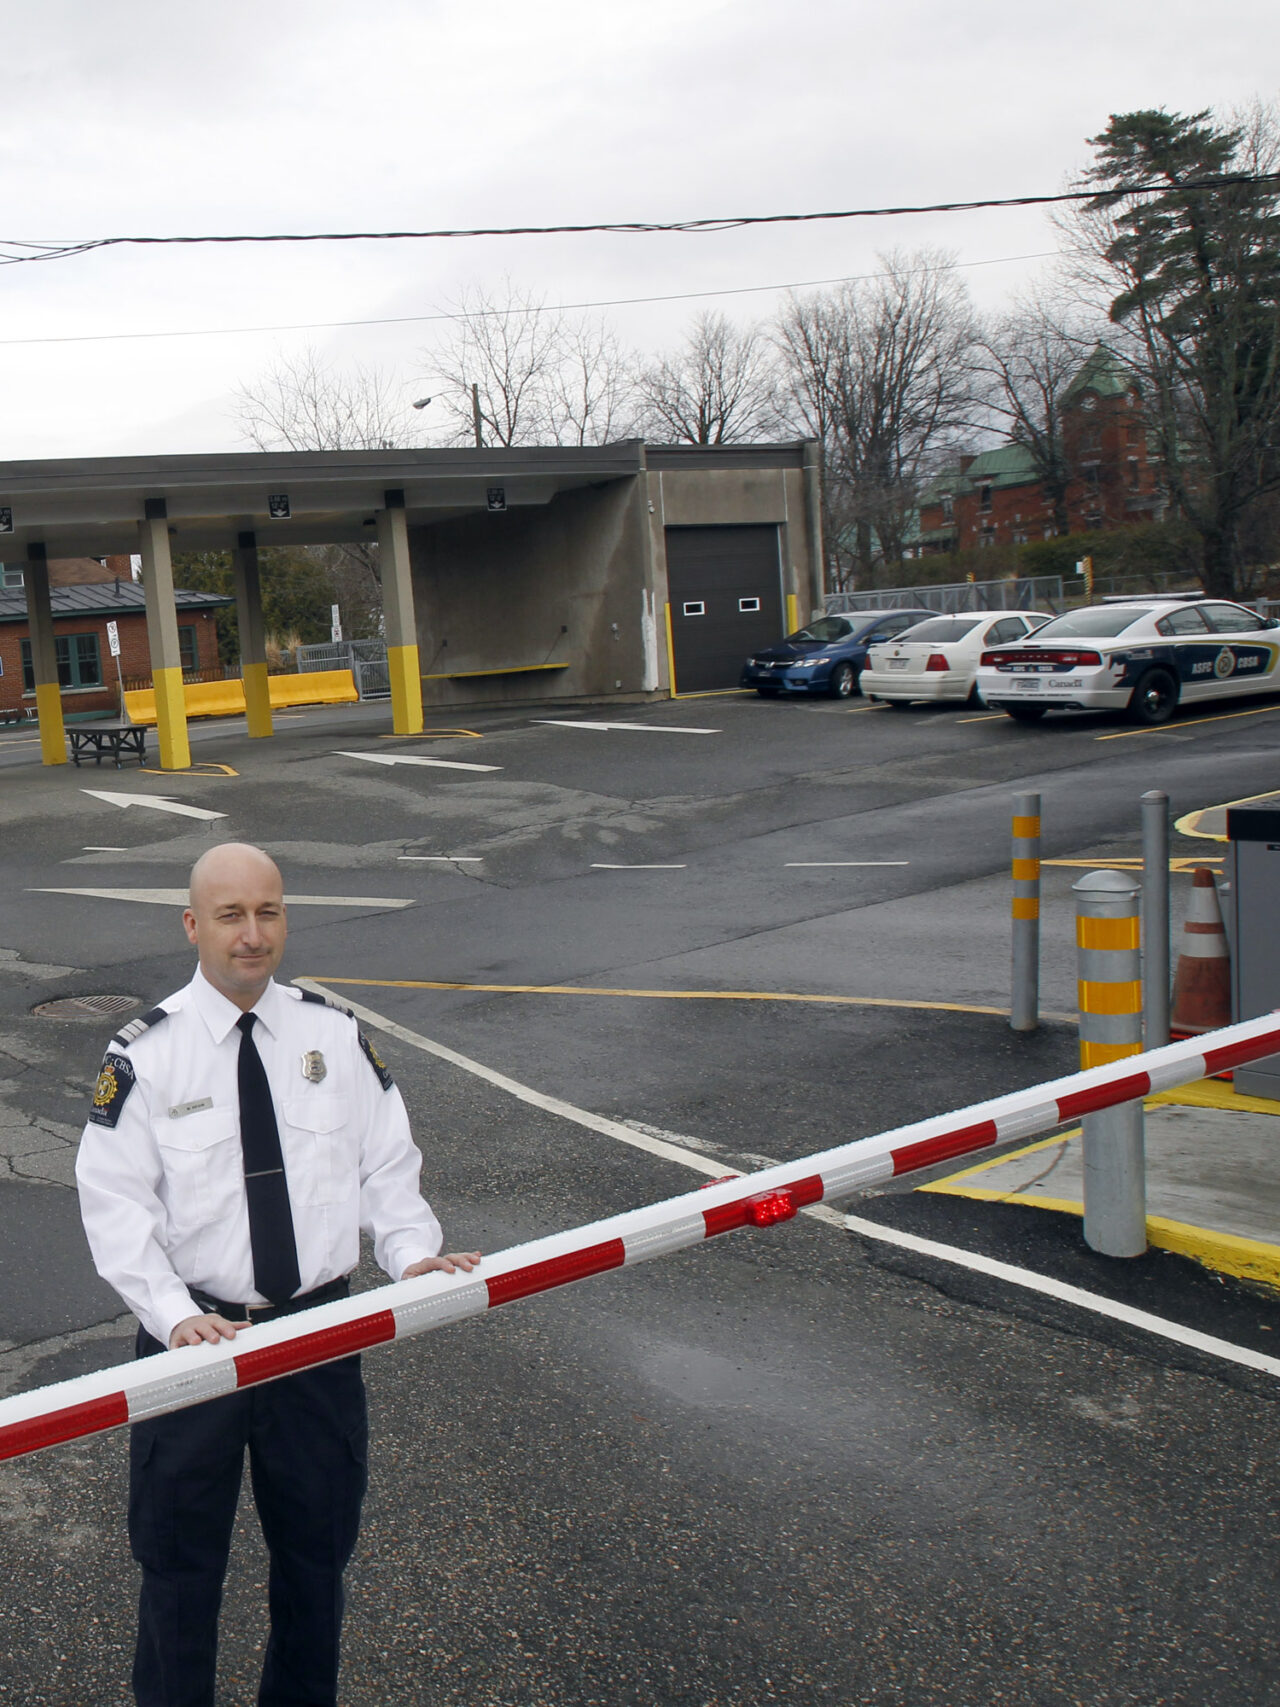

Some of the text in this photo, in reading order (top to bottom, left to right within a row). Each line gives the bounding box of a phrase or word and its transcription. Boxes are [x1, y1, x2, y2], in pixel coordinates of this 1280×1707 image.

[1192, 655, 1260, 675] ASFC CBSA
[1048, 678, 1082, 689] Canada
[113, 1057, 134, 1080] CBSA
